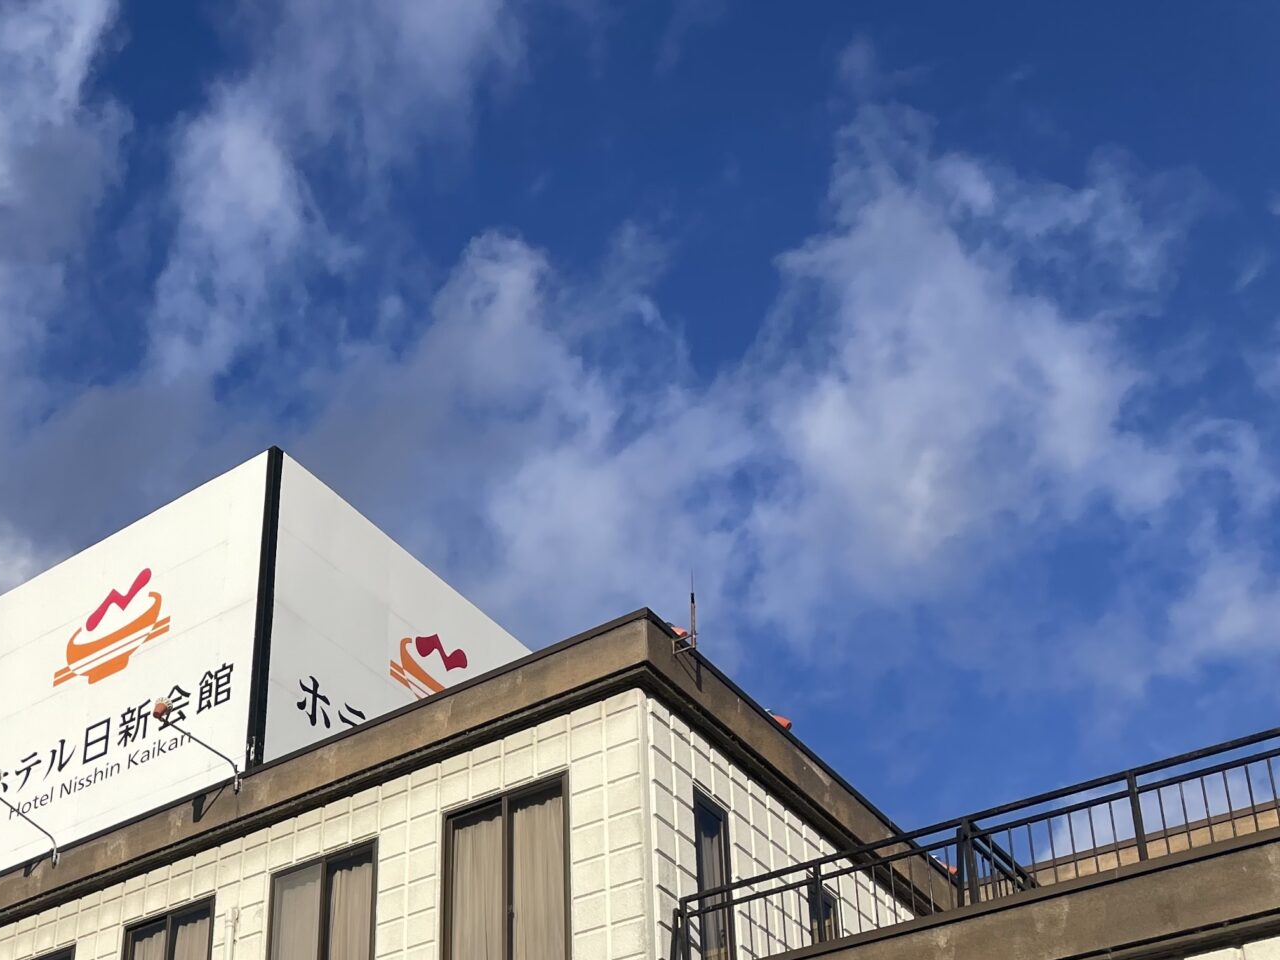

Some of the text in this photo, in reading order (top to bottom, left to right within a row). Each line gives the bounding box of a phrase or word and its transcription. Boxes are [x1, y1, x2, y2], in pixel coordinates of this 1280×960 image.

[8, 731, 192, 821] Hotel Nisshin Kaikan
